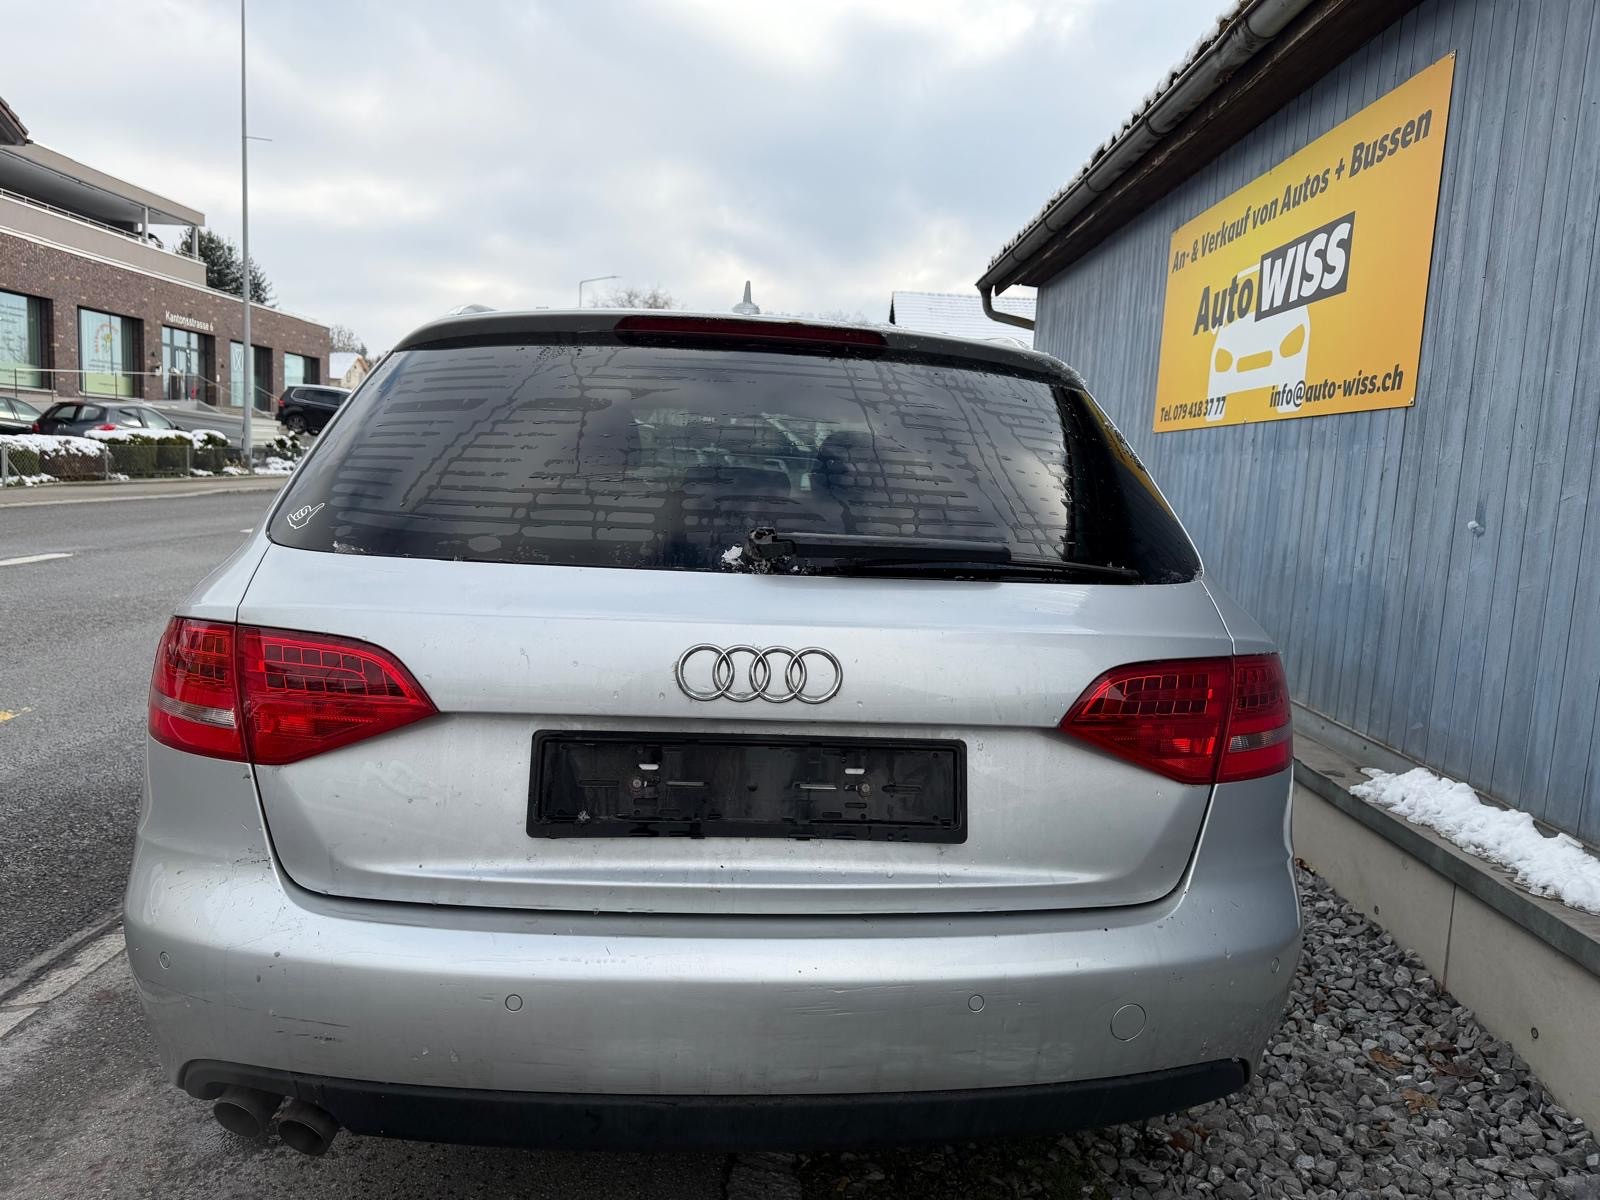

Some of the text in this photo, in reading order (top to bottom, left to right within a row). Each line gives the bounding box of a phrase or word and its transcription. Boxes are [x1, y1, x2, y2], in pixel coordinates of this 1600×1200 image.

[1172, 109, 1433, 273] An- & Verkauf von Autos + Bussen
[1193, 222, 1352, 336] Auto WISS
[165, 309, 209, 331] Kantonsstrasse
[1270, 364, 1404, 408] info@auto-wiss.ch
[1160, 405, 1172, 422] Tel.
[1173, 403, 1188, 420] 079
[1188, 400, 1203, 418] 418
[1214, 395, 1226, 415] 77
